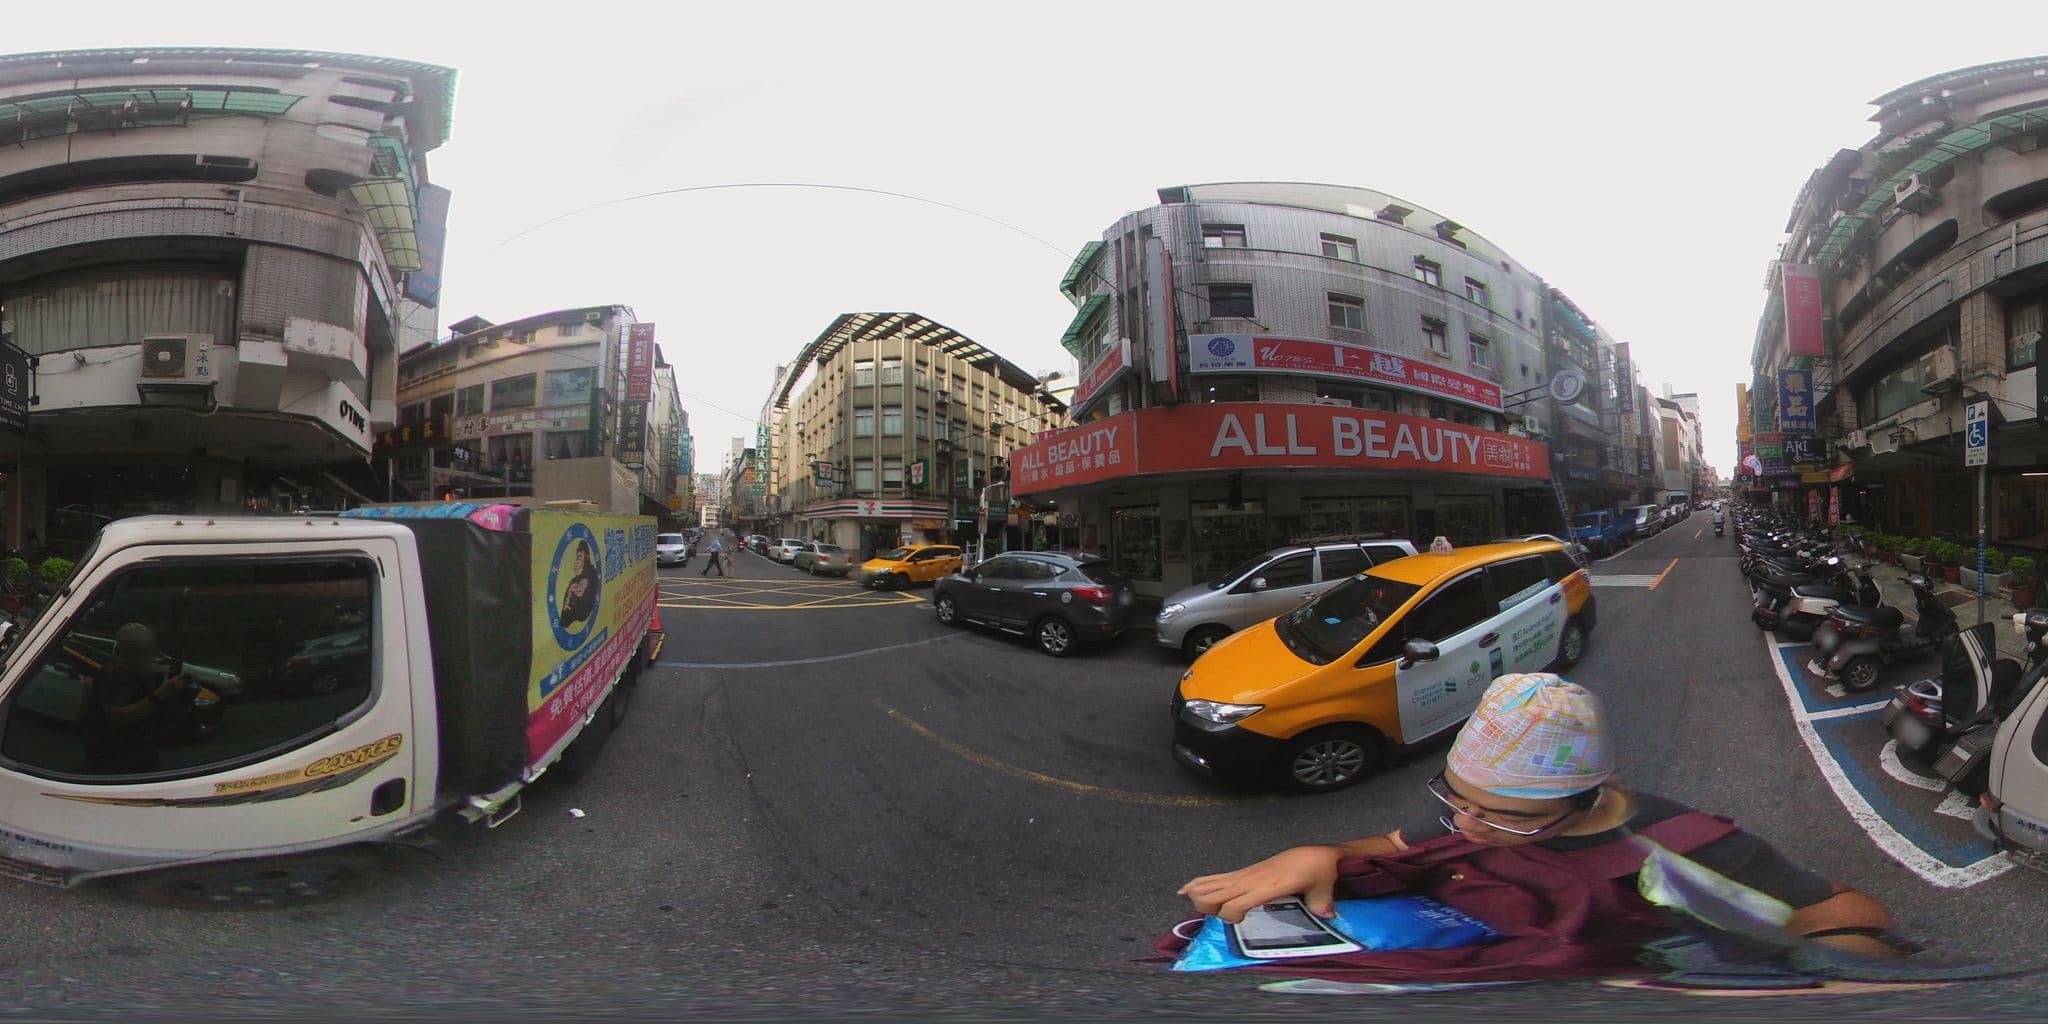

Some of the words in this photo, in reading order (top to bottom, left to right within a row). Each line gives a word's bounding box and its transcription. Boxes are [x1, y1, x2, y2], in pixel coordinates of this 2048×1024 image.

[1020, 451, 1045, 473] ALL
[1048, 426, 1117, 464] BEAUTY
[1210, 413, 1318, 458] ALL
[1332, 415, 1482, 466] BEAUTY
[304, 733, 402, 777] CANTER
